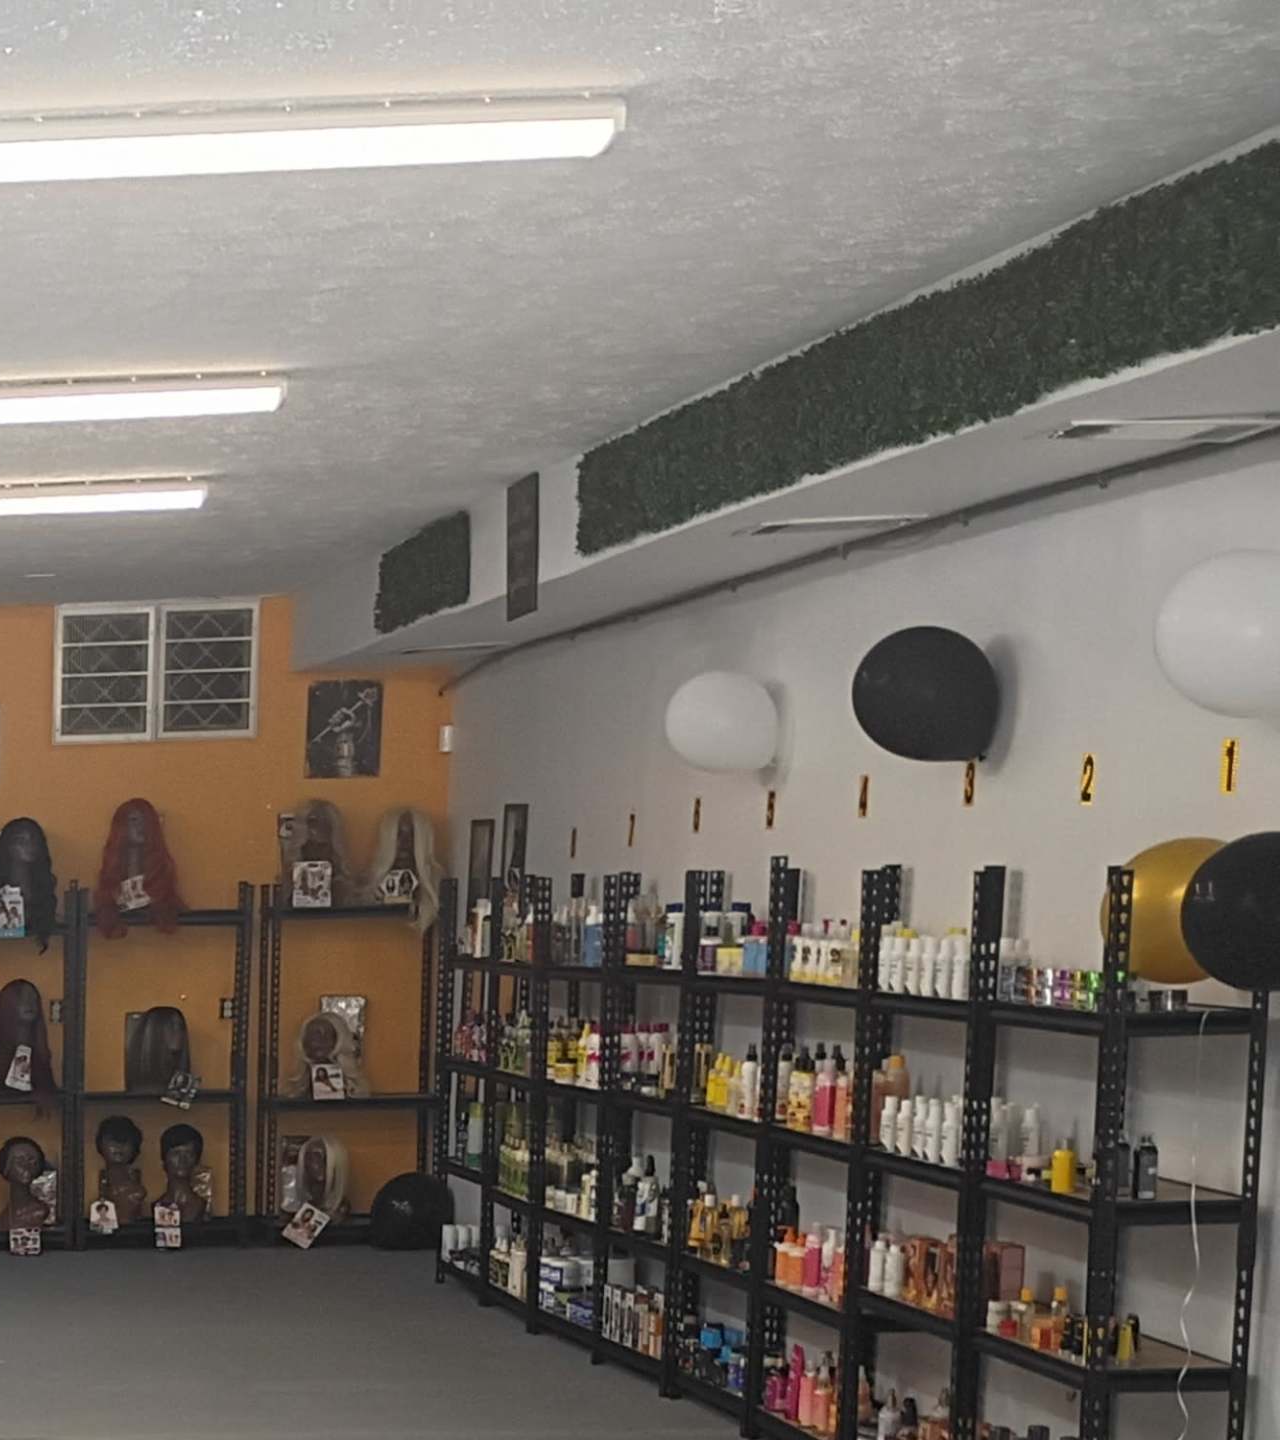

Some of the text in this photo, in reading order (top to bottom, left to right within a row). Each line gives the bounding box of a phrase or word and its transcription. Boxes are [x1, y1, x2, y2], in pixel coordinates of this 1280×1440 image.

[964, 761, 976, 804] 3
[1080, 754, 1094, 802] 2
[1226, 740, 1236, 792] 1
[766, 790, 776, 828] 5
[858, 775, 869, 817] 4
